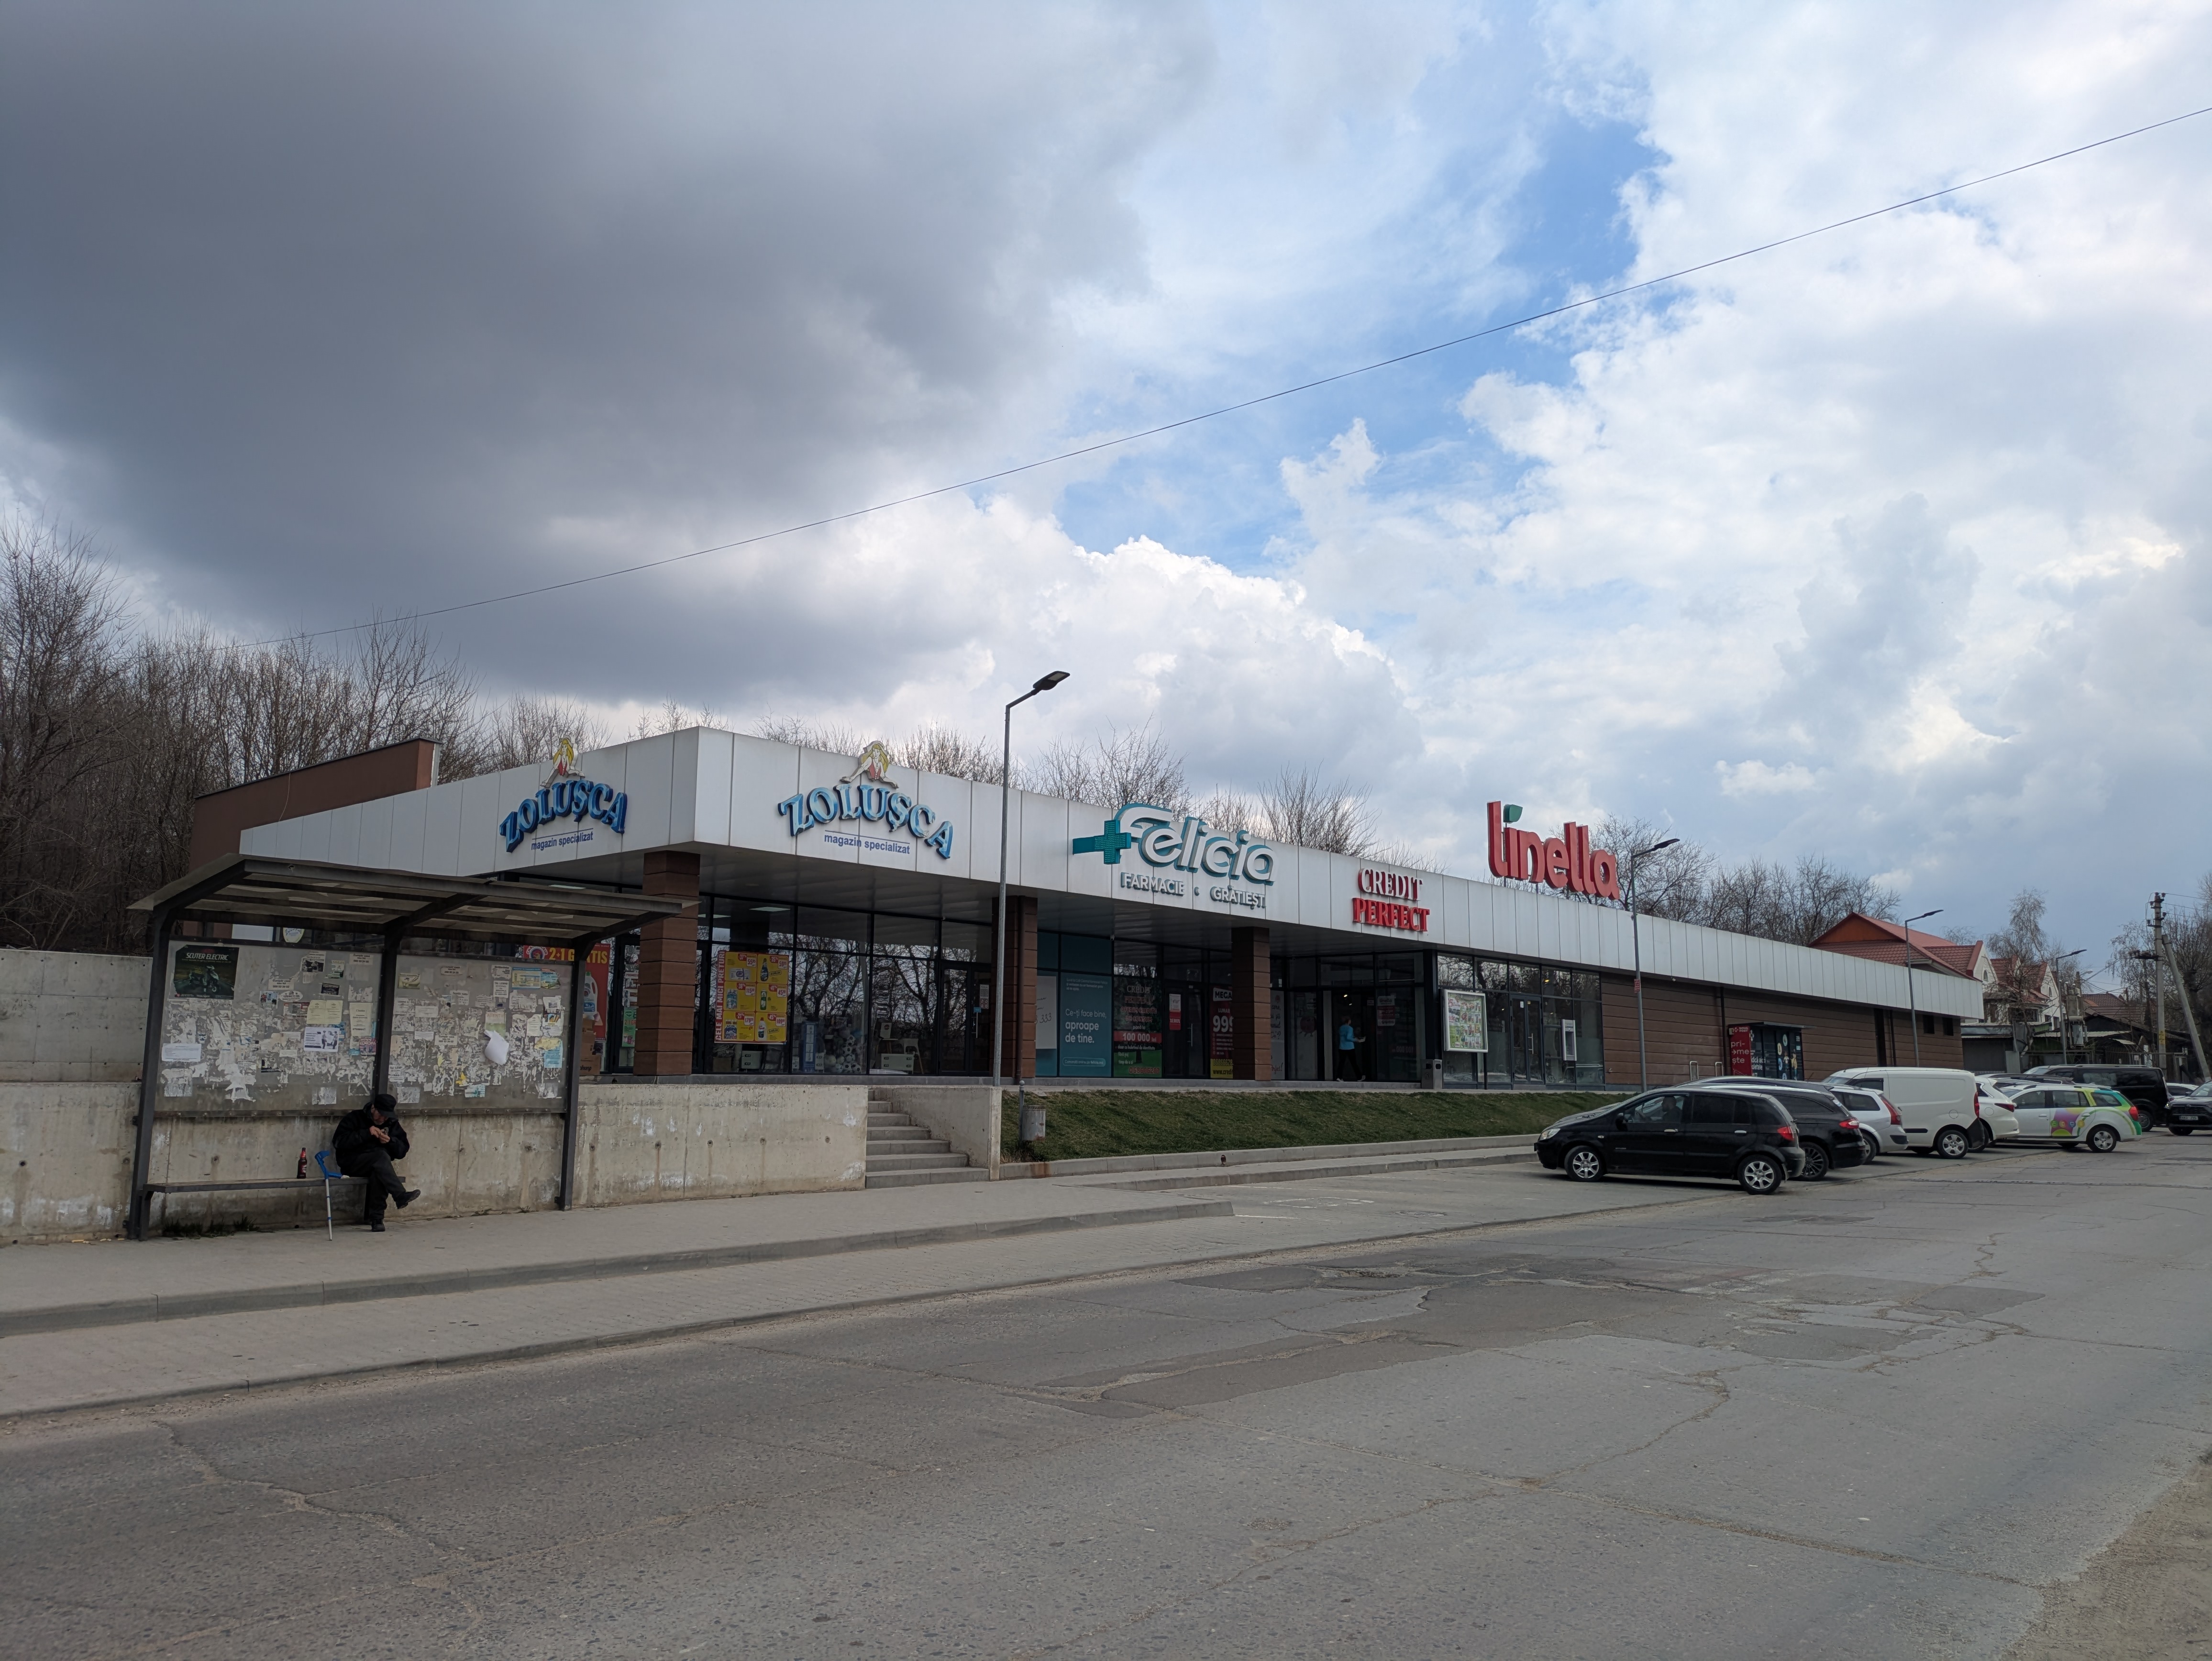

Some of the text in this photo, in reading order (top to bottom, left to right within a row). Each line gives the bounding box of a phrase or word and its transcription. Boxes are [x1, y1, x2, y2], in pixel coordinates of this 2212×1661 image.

[531, 831, 594, 851] magazin specializat
[824, 833, 910, 854] magazin specializat
[1114, 803, 1275, 886] Felicia
[1487, 800, 1620, 900] linella
[1121, 872, 1185, 897] FARMACIE
[1358, 868, 1424, 901] CREDIT
[1352, 897, 1430, 932] PERFECT
[1127, 985, 1151, 994] CREDIT
[1215, 991, 1232, 999] MEGA
[1065, 1008, 1080, 1018] Ce-ți
[1094, 1010, 1106, 1019] bine,
[1065, 1021, 1099, 1032] aproape
[1065, 1033, 1095, 1043] de tine.
[1122, 1033, 1135, 1041] 100
[1137, 1033, 1150, 1042] 000
[1731, 1040, 1745, 1048] pri-
[1732, 1056, 1745, 1065] ște
